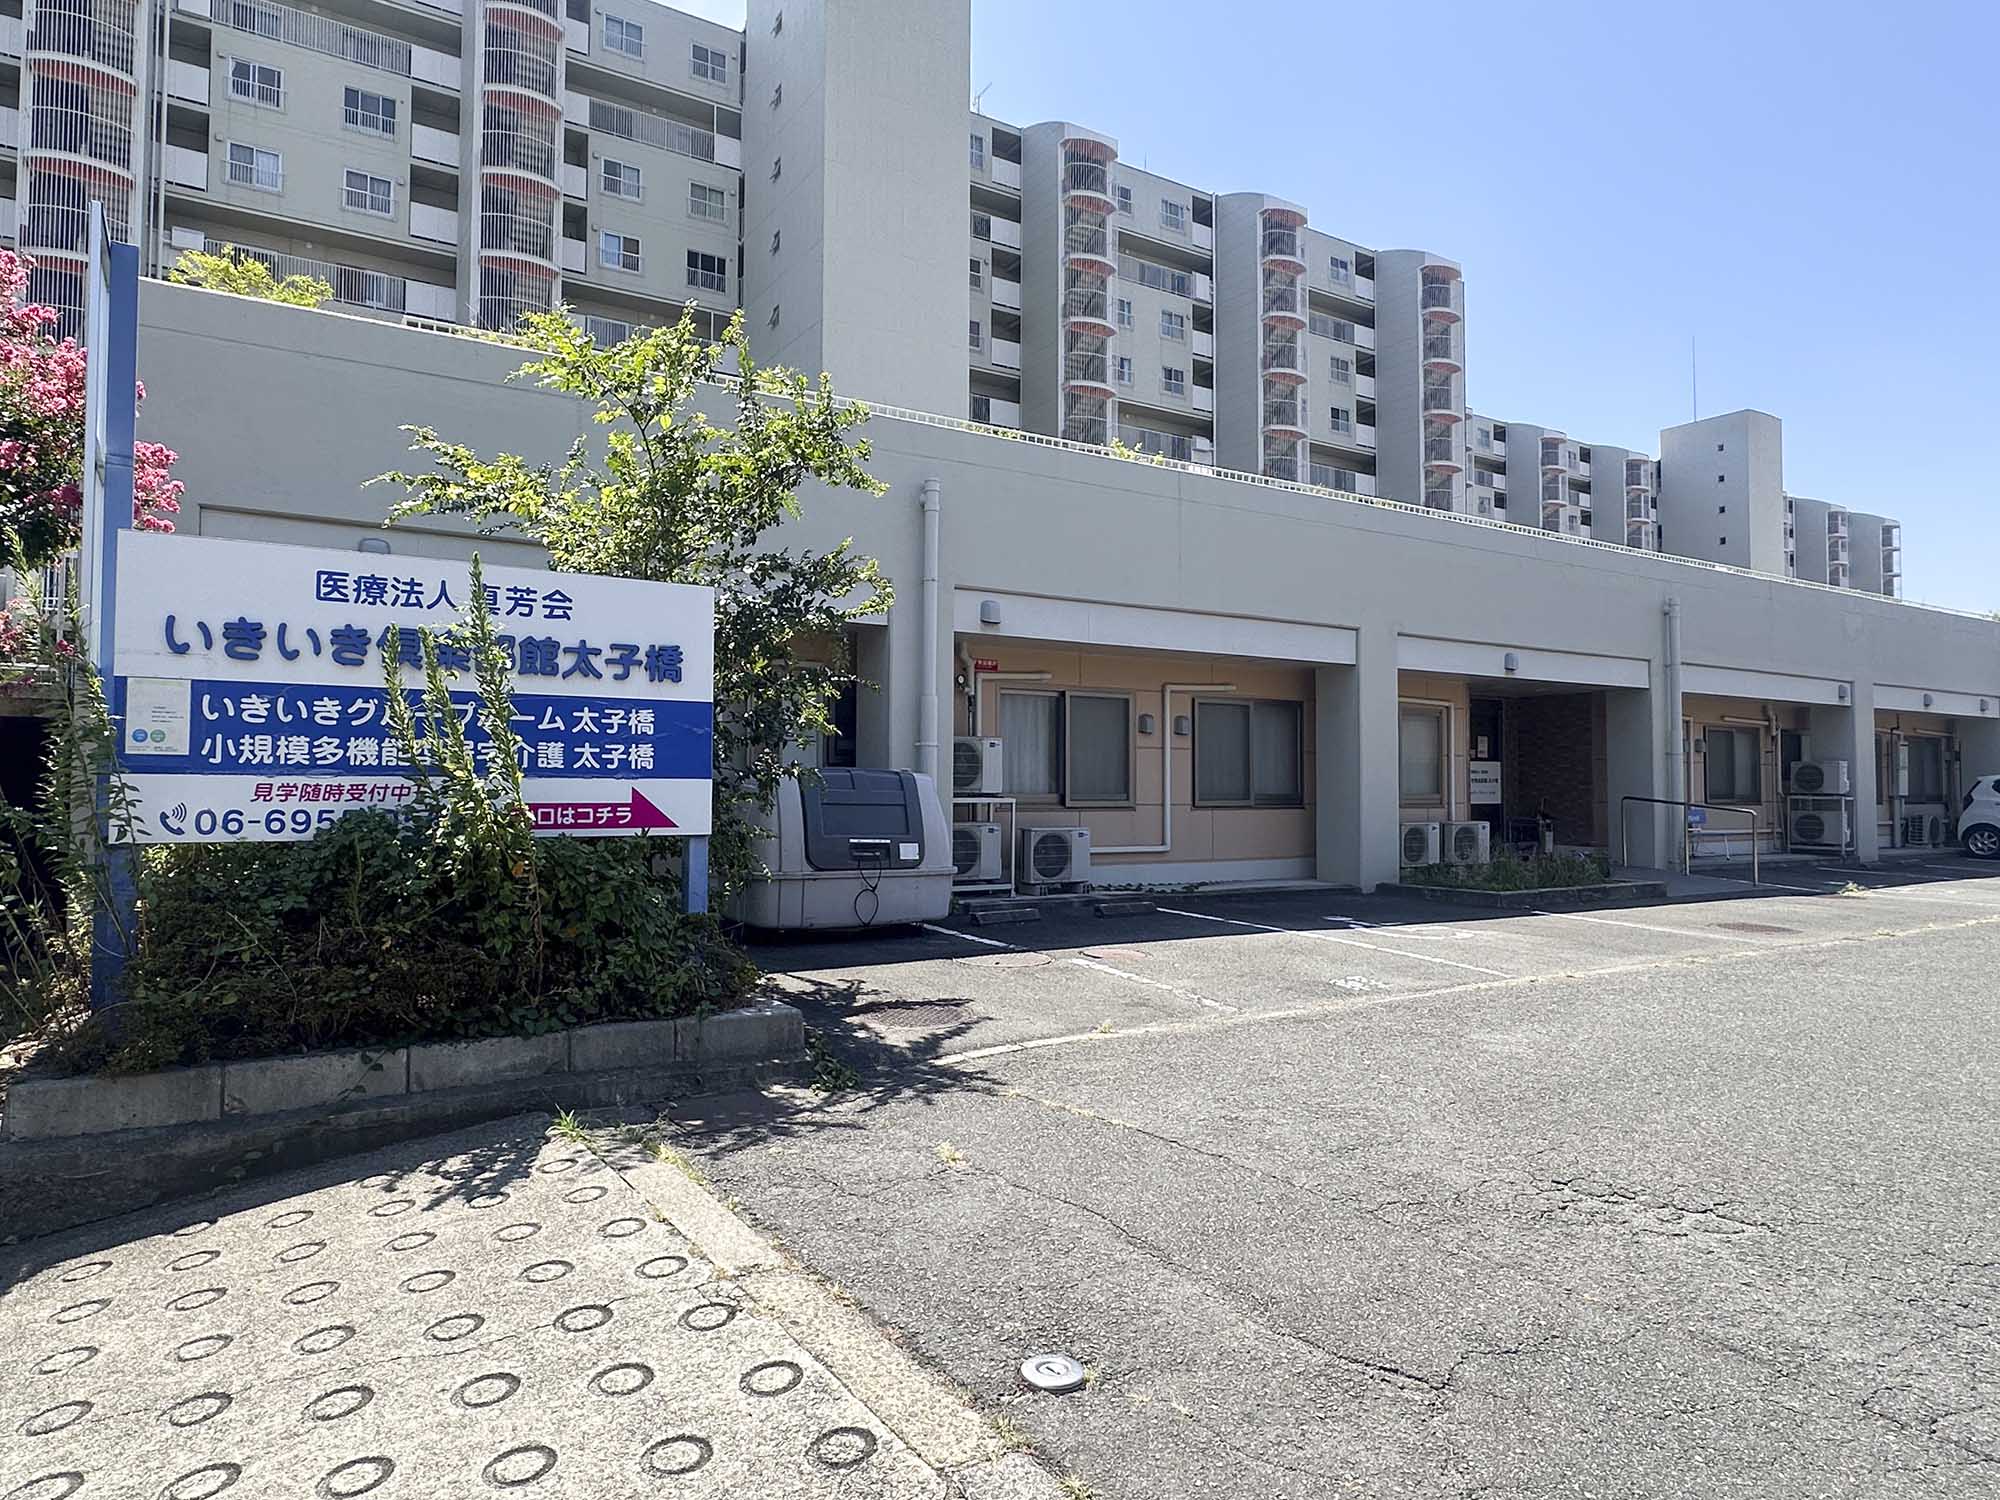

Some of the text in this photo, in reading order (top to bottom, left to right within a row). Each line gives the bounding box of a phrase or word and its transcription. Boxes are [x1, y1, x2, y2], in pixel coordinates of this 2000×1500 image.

[526, 806, 633, 825] 口はコチラ
